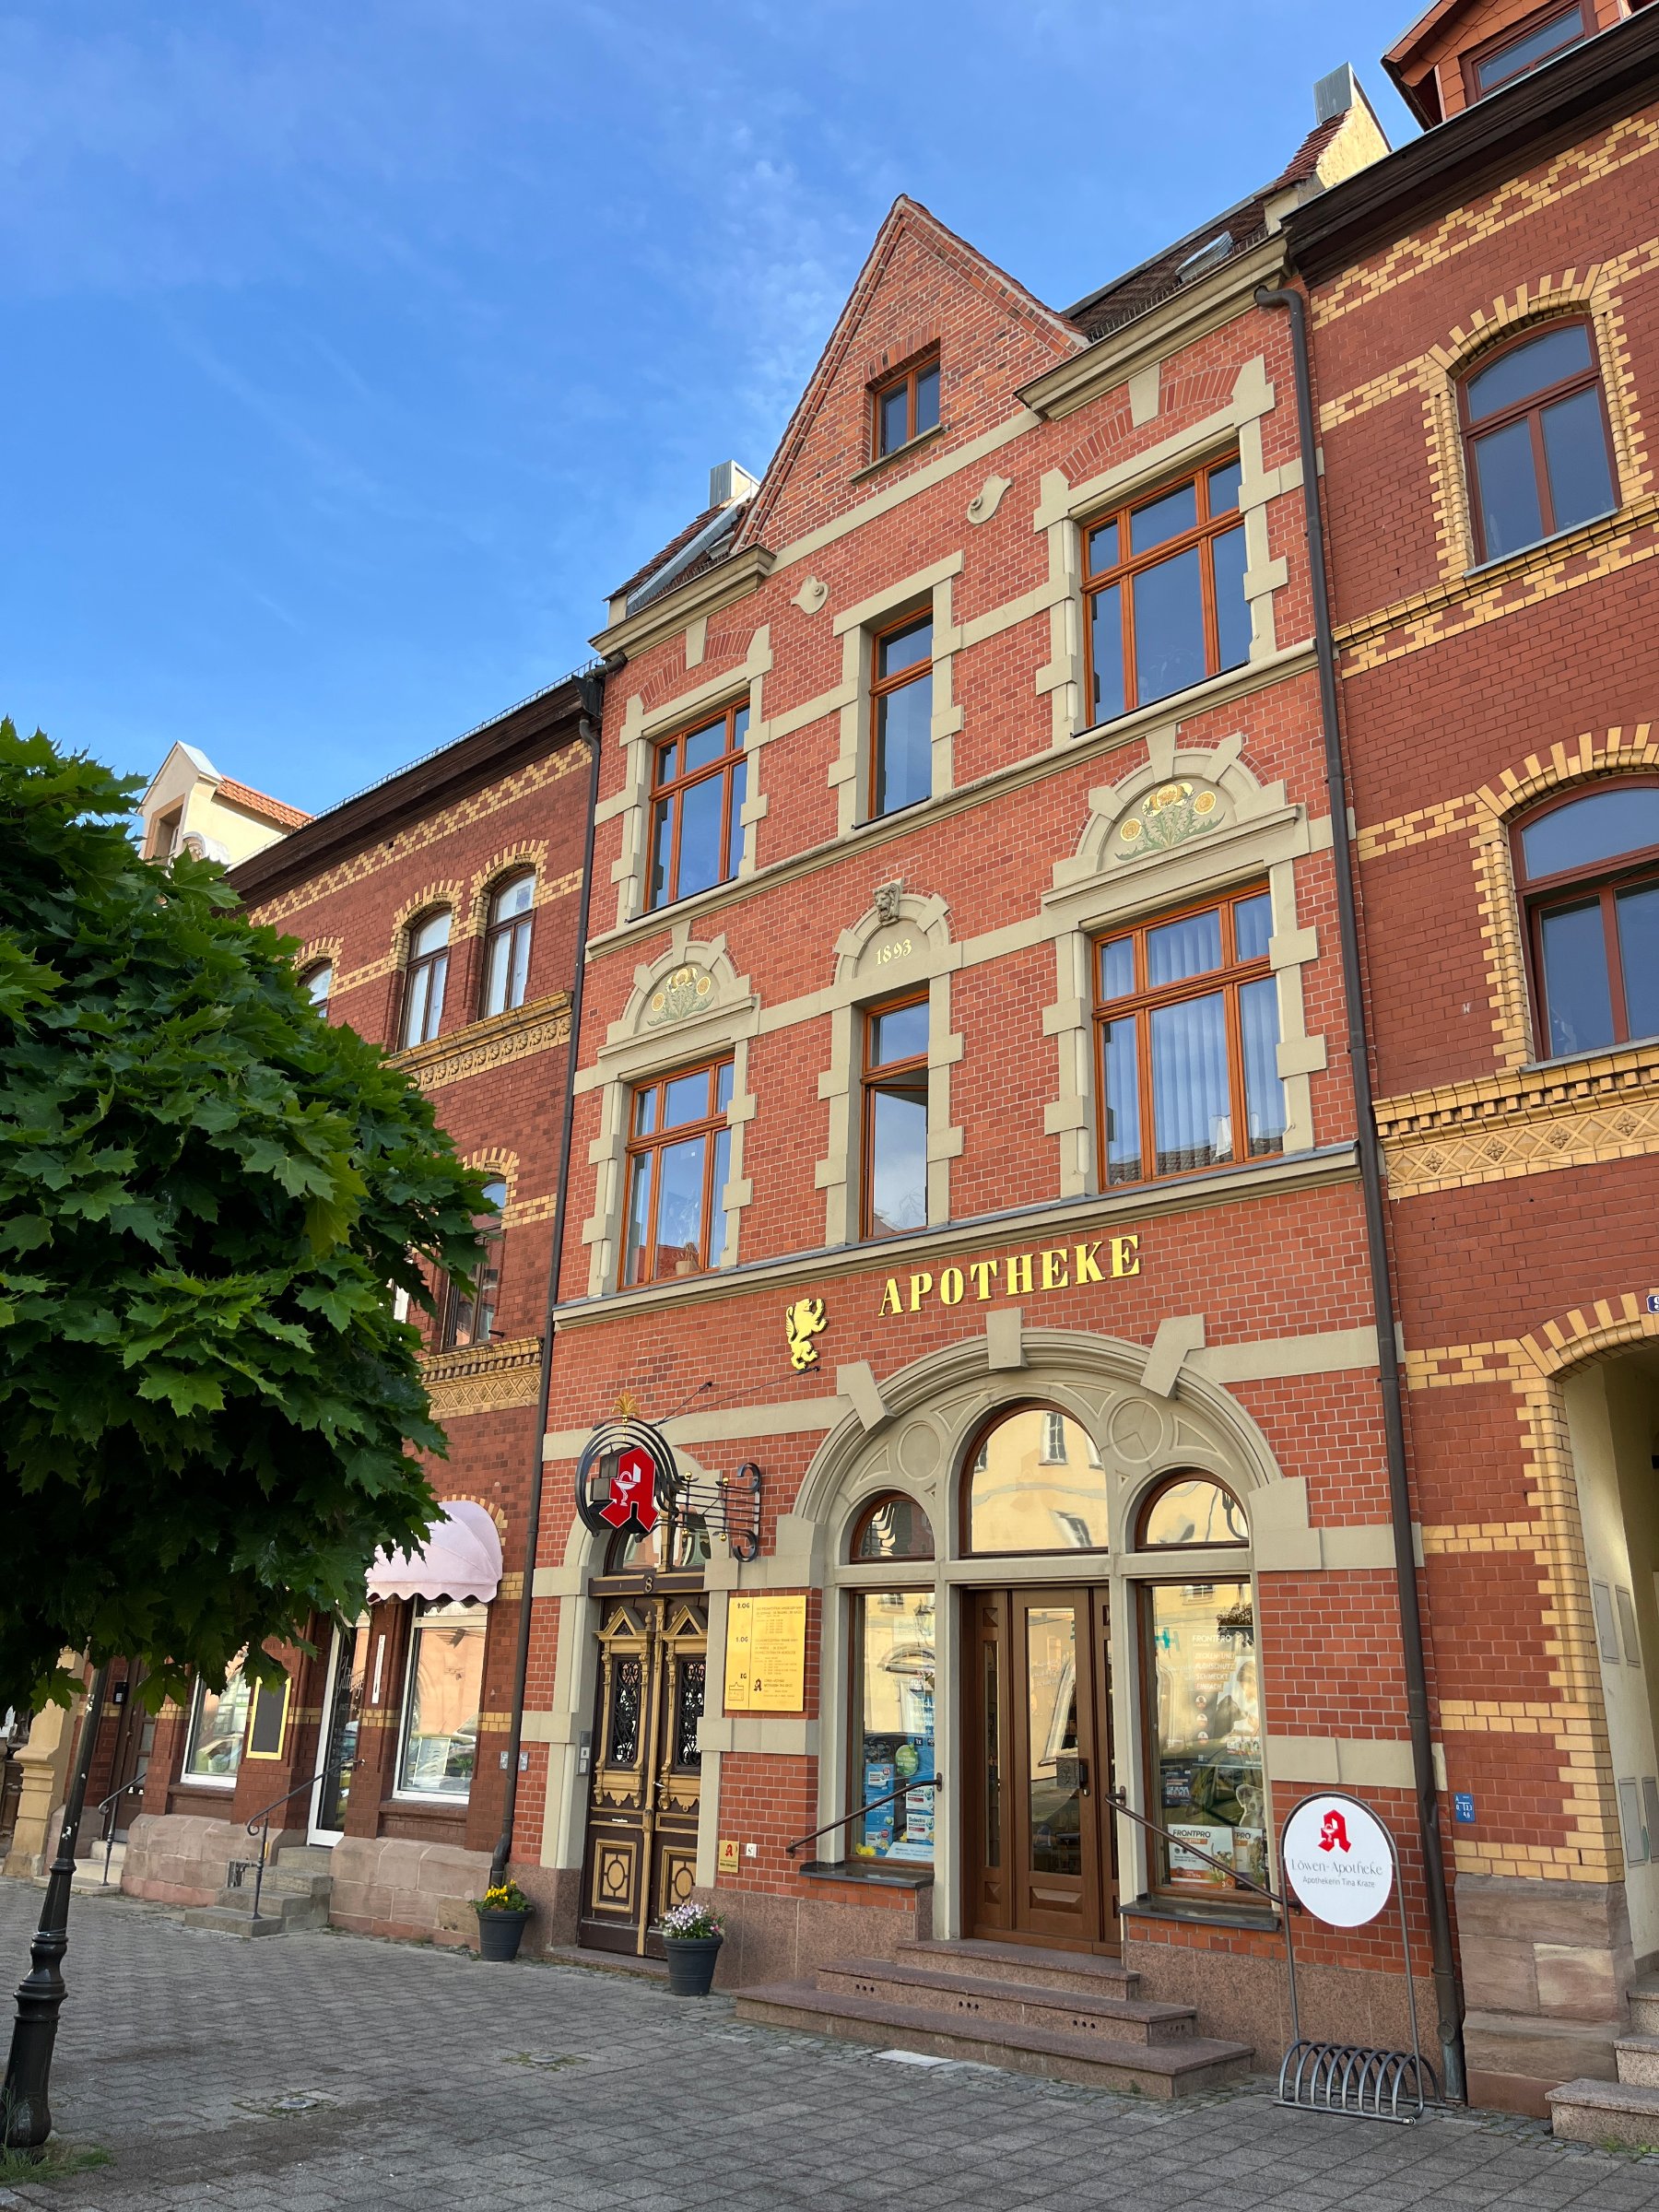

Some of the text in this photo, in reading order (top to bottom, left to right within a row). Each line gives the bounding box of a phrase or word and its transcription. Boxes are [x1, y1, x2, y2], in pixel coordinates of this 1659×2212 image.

[876, 938, 912, 967] 1893
[878, 1234, 1141, 1317] APOTHEKE
[643, 1576, 653, 1594] 8
[1172, 1829, 1211, 1838] FRONTPRO
[1291, 1858, 1383, 1877] Löwen-Apotheke
[1302, 1876, 1375, 1888] Apothekerin Tina Kraze
